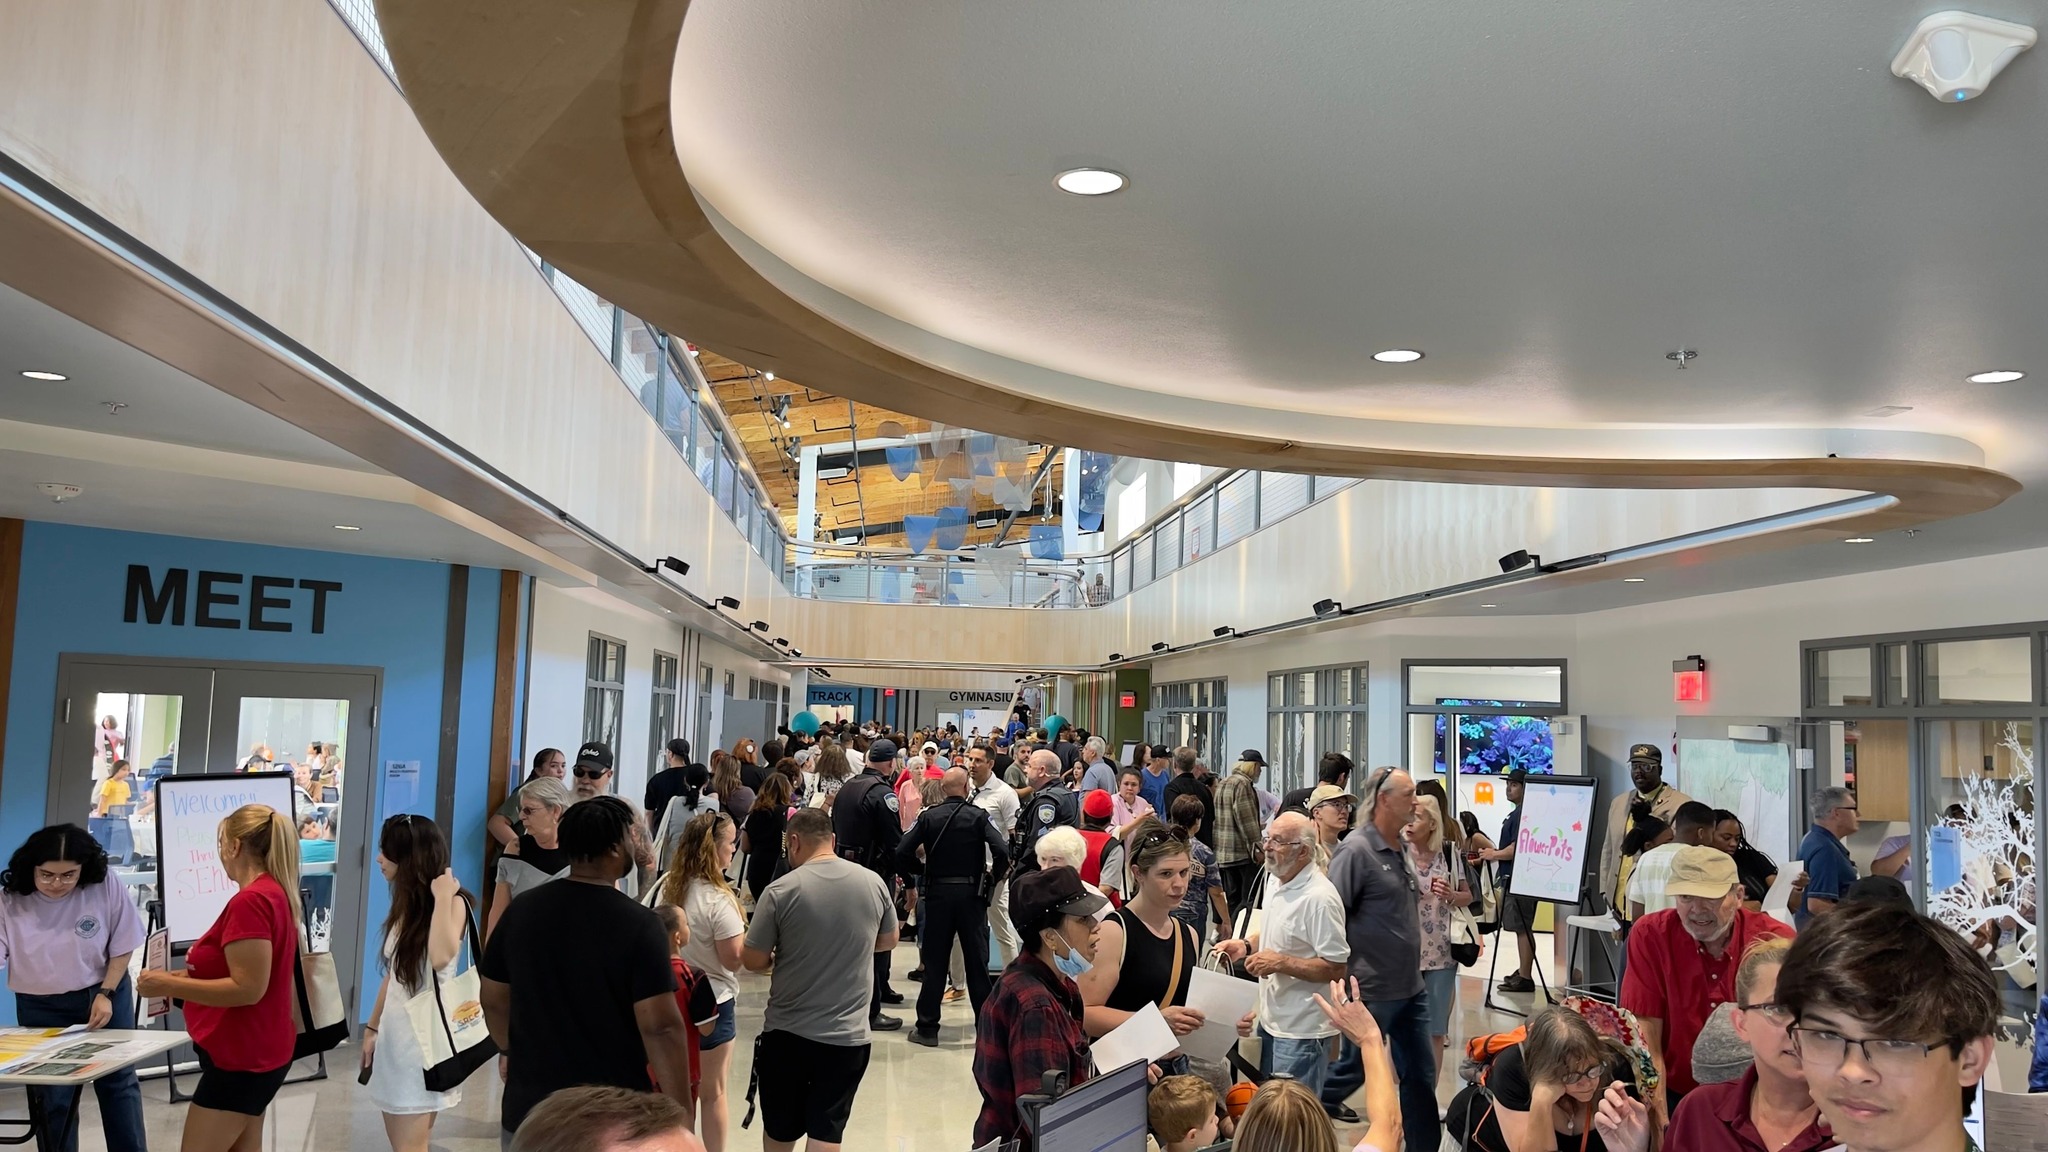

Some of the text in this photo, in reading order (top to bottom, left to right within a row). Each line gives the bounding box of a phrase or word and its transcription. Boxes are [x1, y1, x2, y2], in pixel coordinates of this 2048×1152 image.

[123, 563, 343, 634] MEET
[811, 691, 852, 702] TRACK
[949, 691, 1014, 703] GYMNASIU
